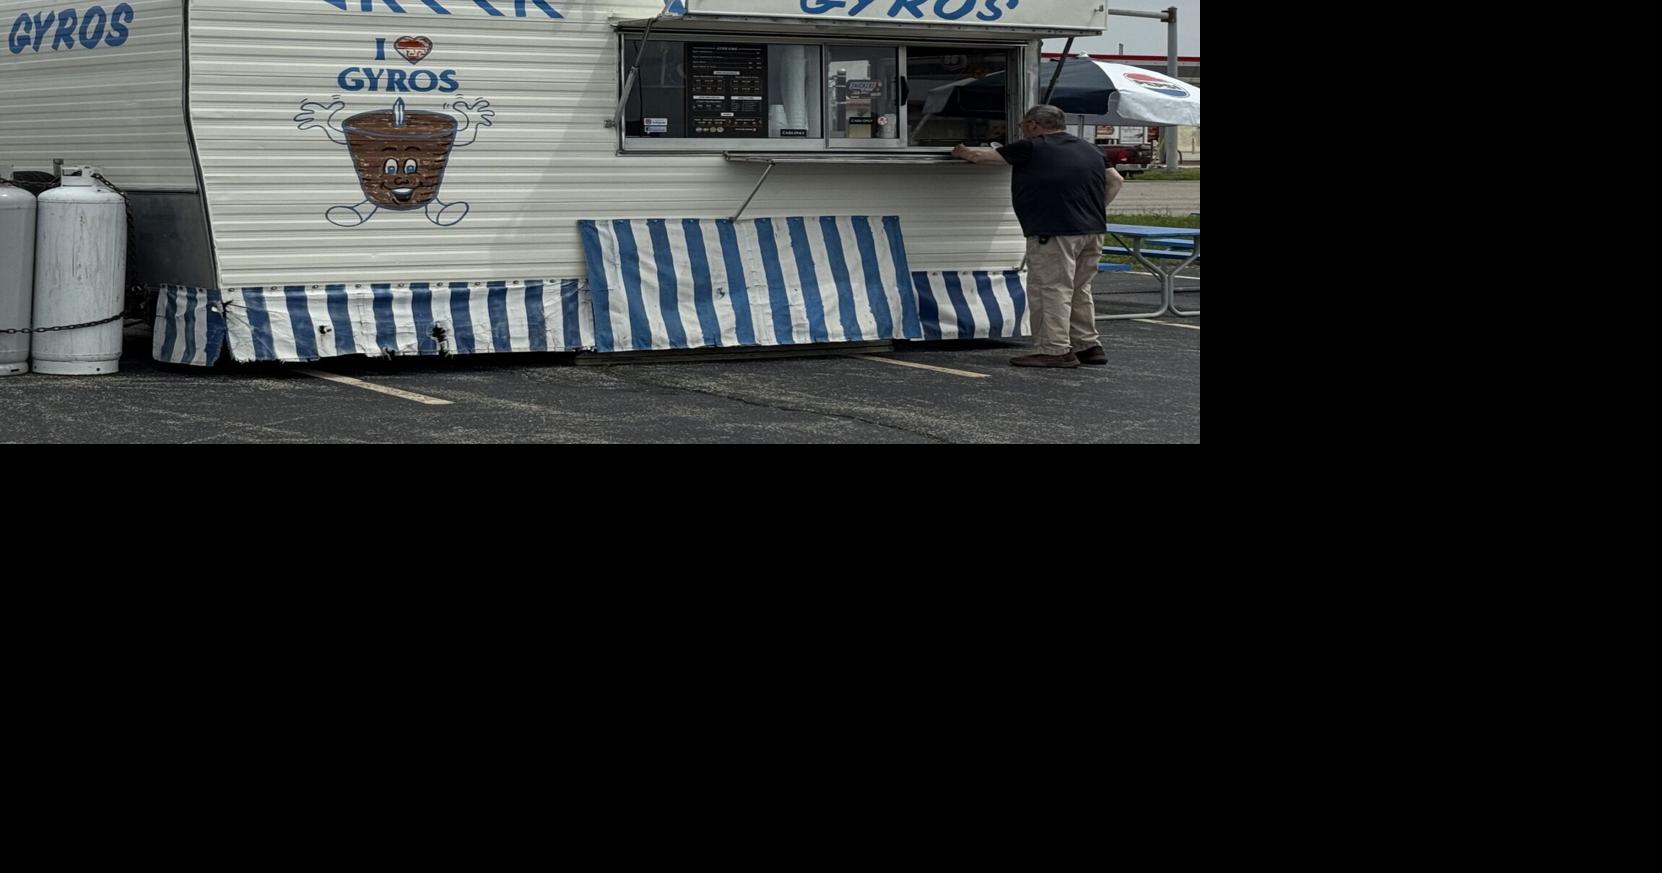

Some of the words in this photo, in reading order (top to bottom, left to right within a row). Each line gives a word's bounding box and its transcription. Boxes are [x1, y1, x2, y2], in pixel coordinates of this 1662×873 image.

[8, 2, 134, 54] GYROS
[374, 37, 386, 61] I
[337, 66, 460, 93] GYROS
